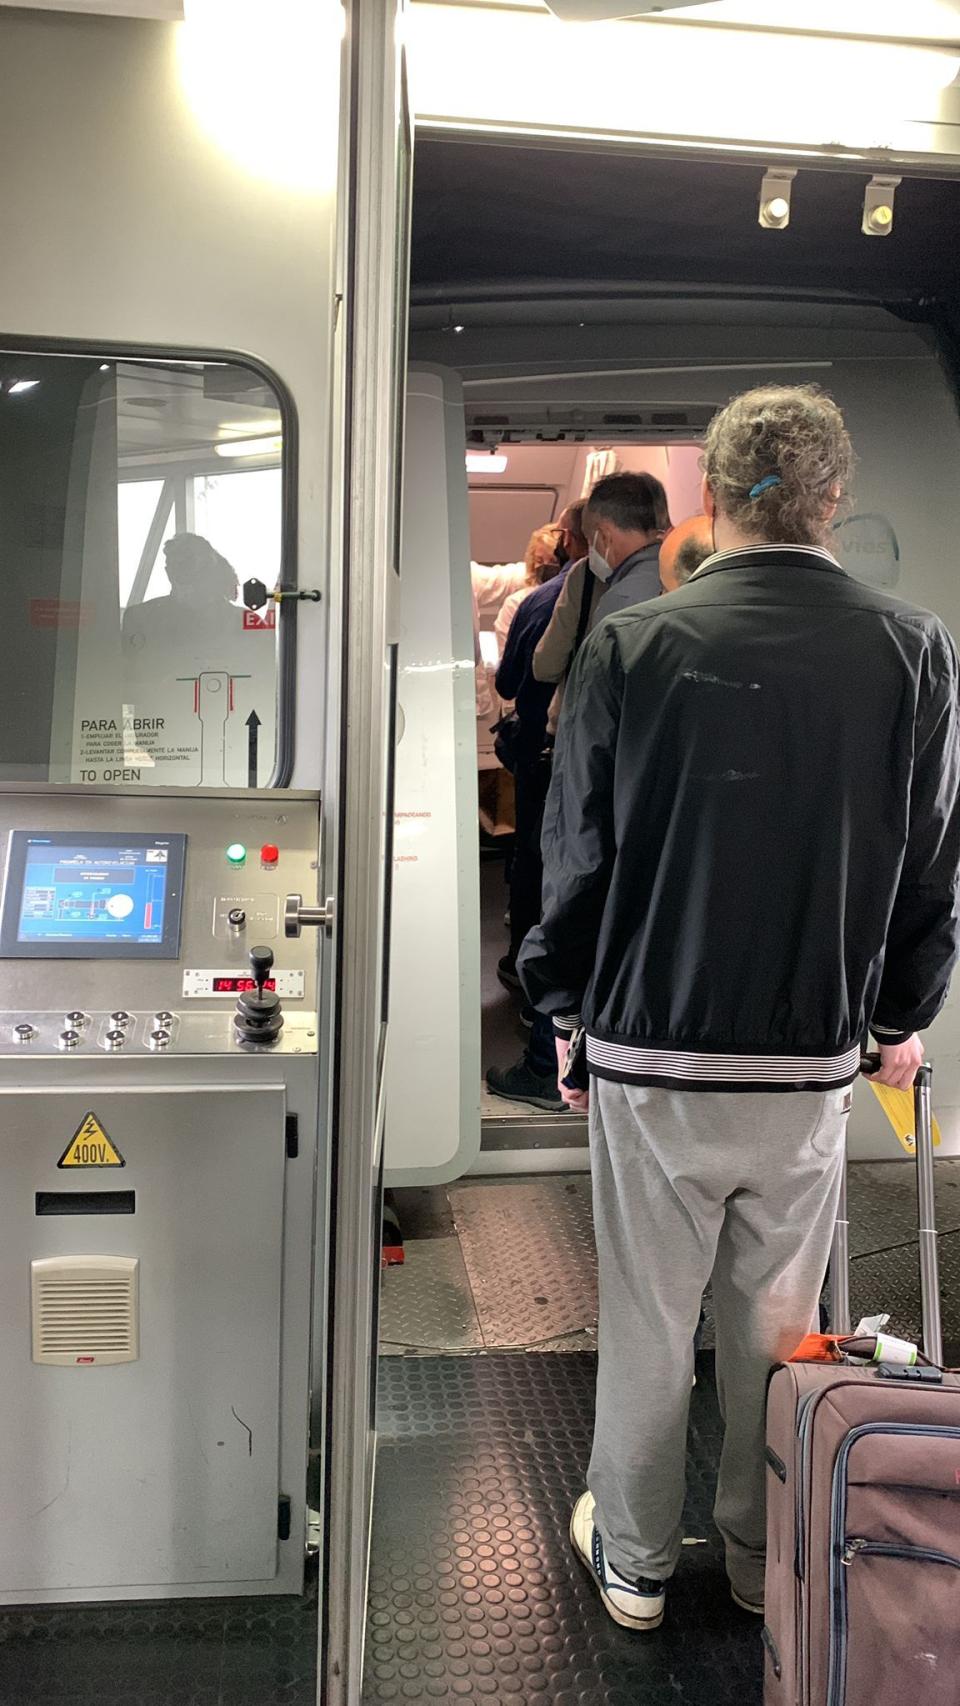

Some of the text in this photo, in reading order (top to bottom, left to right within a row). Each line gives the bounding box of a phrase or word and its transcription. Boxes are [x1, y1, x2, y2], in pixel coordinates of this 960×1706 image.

[81, 718, 165, 731] PARA ABRIR
[80, 769, 141, 781] TO OPEN
